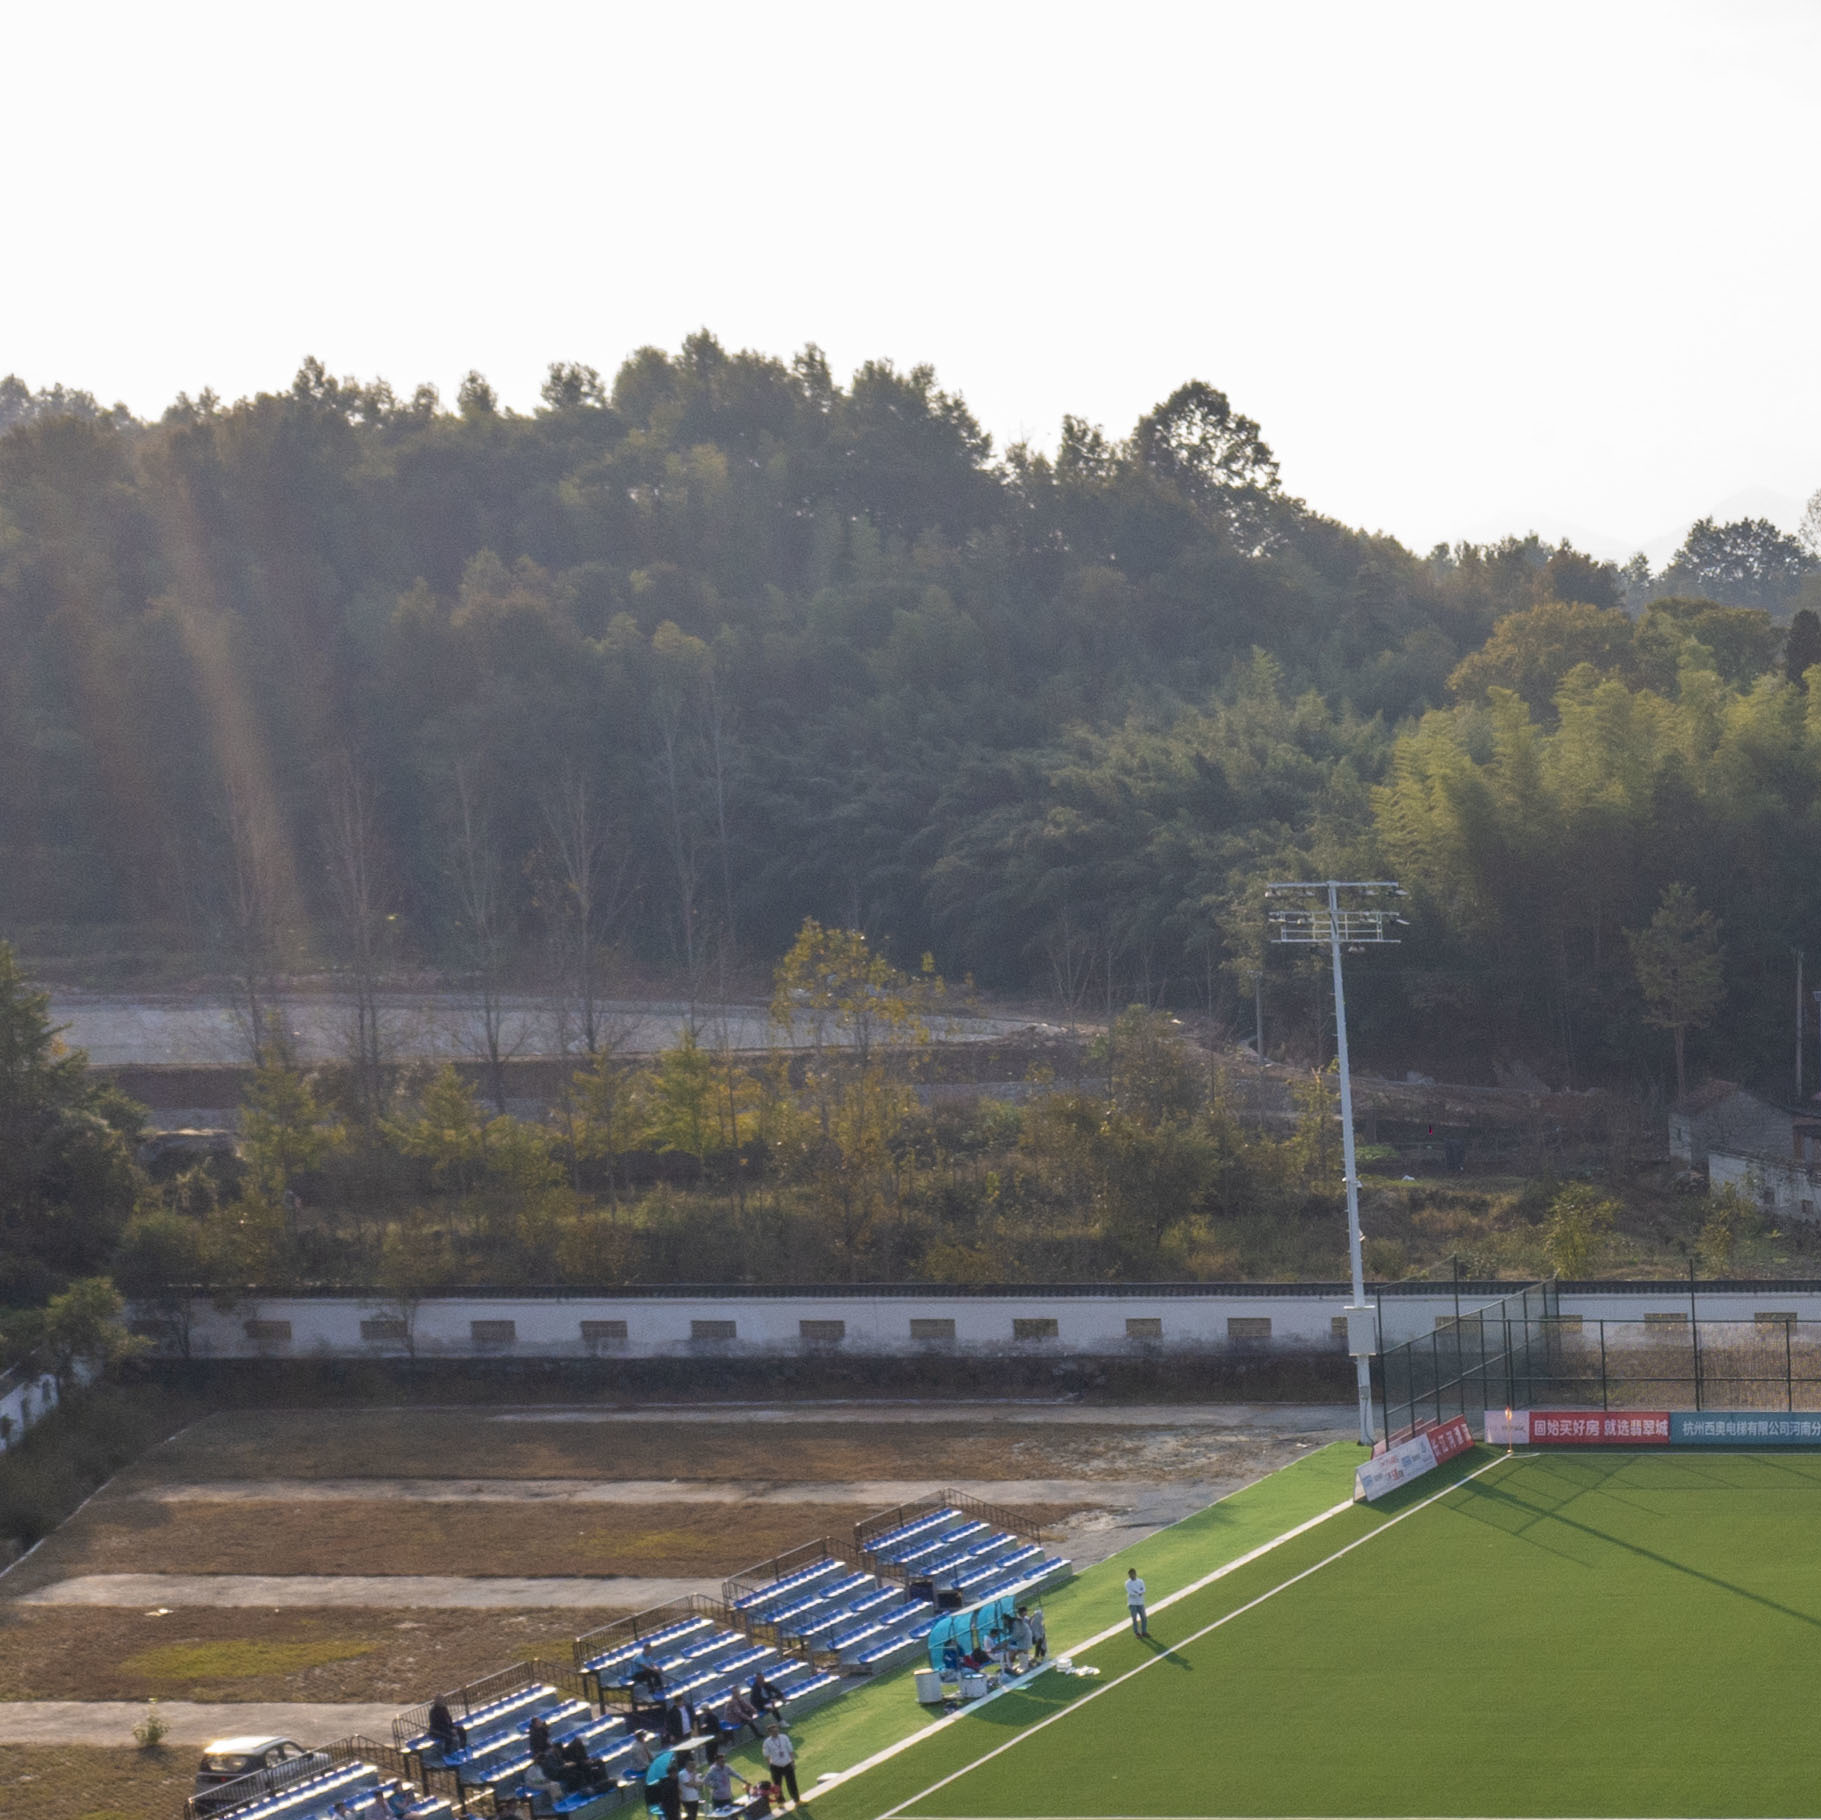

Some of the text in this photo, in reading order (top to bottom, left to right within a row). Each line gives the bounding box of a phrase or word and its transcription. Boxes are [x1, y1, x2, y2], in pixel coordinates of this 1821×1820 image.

[1534, 1418, 1600, 1436] 固始买好房
[1603, 1418, 1669, 1436] 就选翡翠城
